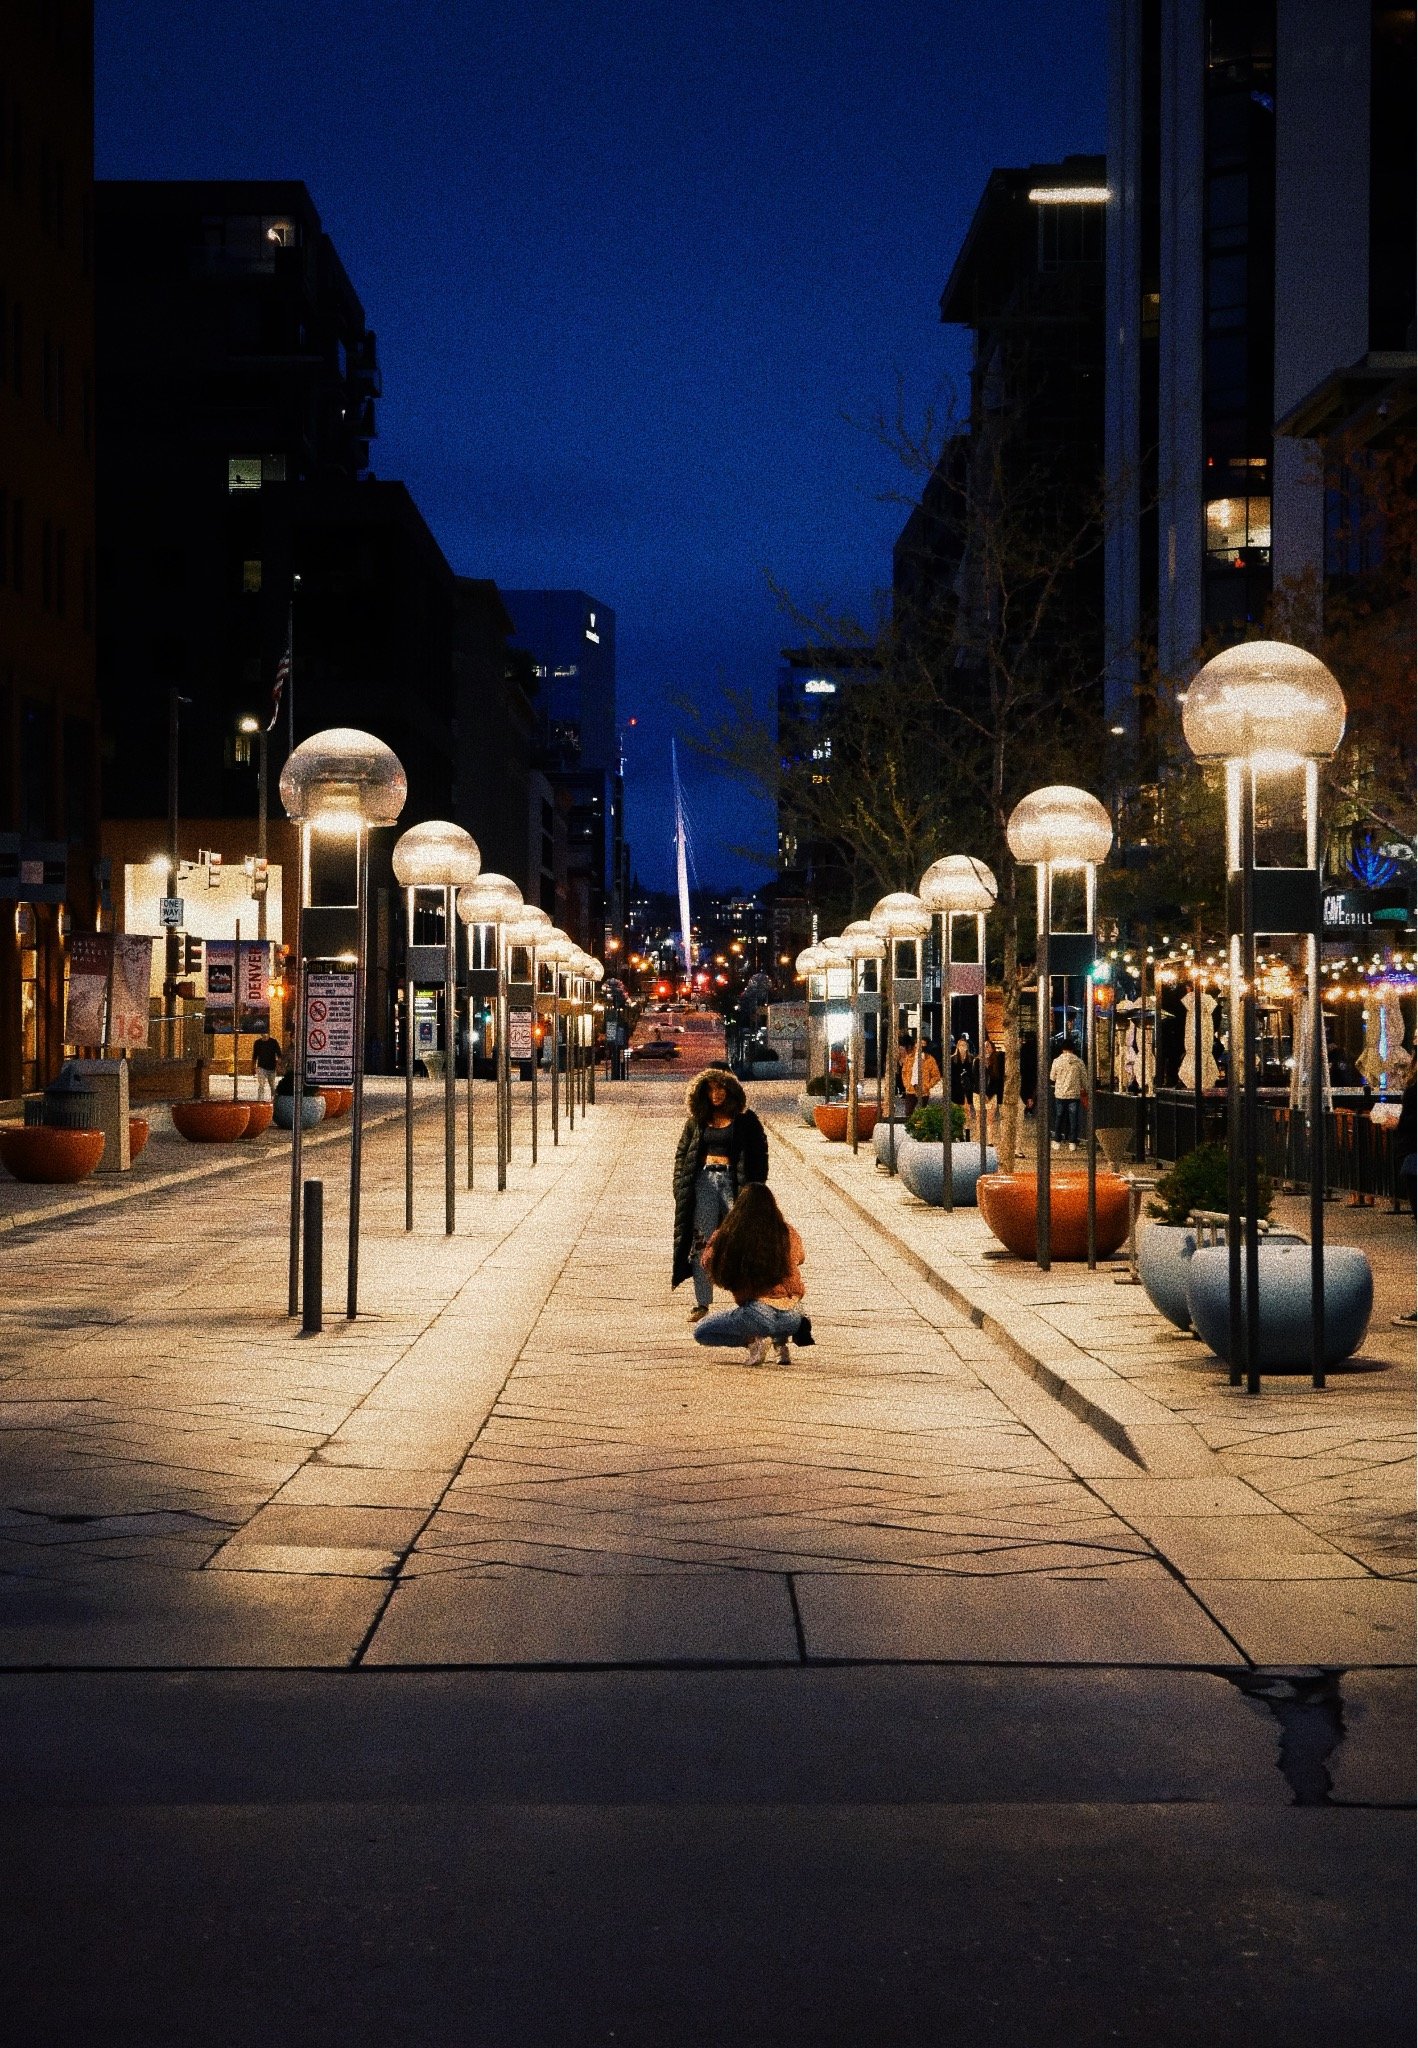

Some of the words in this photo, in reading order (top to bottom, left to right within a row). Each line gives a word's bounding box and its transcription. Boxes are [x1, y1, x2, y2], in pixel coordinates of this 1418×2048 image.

[163, 899, 179, 907] ONE
[163, 908, 179, 916] WAY
[1345, 912, 1373, 925] GRILL
[73, 948, 108, 956] STREET
[72, 955, 96, 963] MALL
[115, 1013, 144, 1040] 16
[307, 1061, 316, 1074] NO
